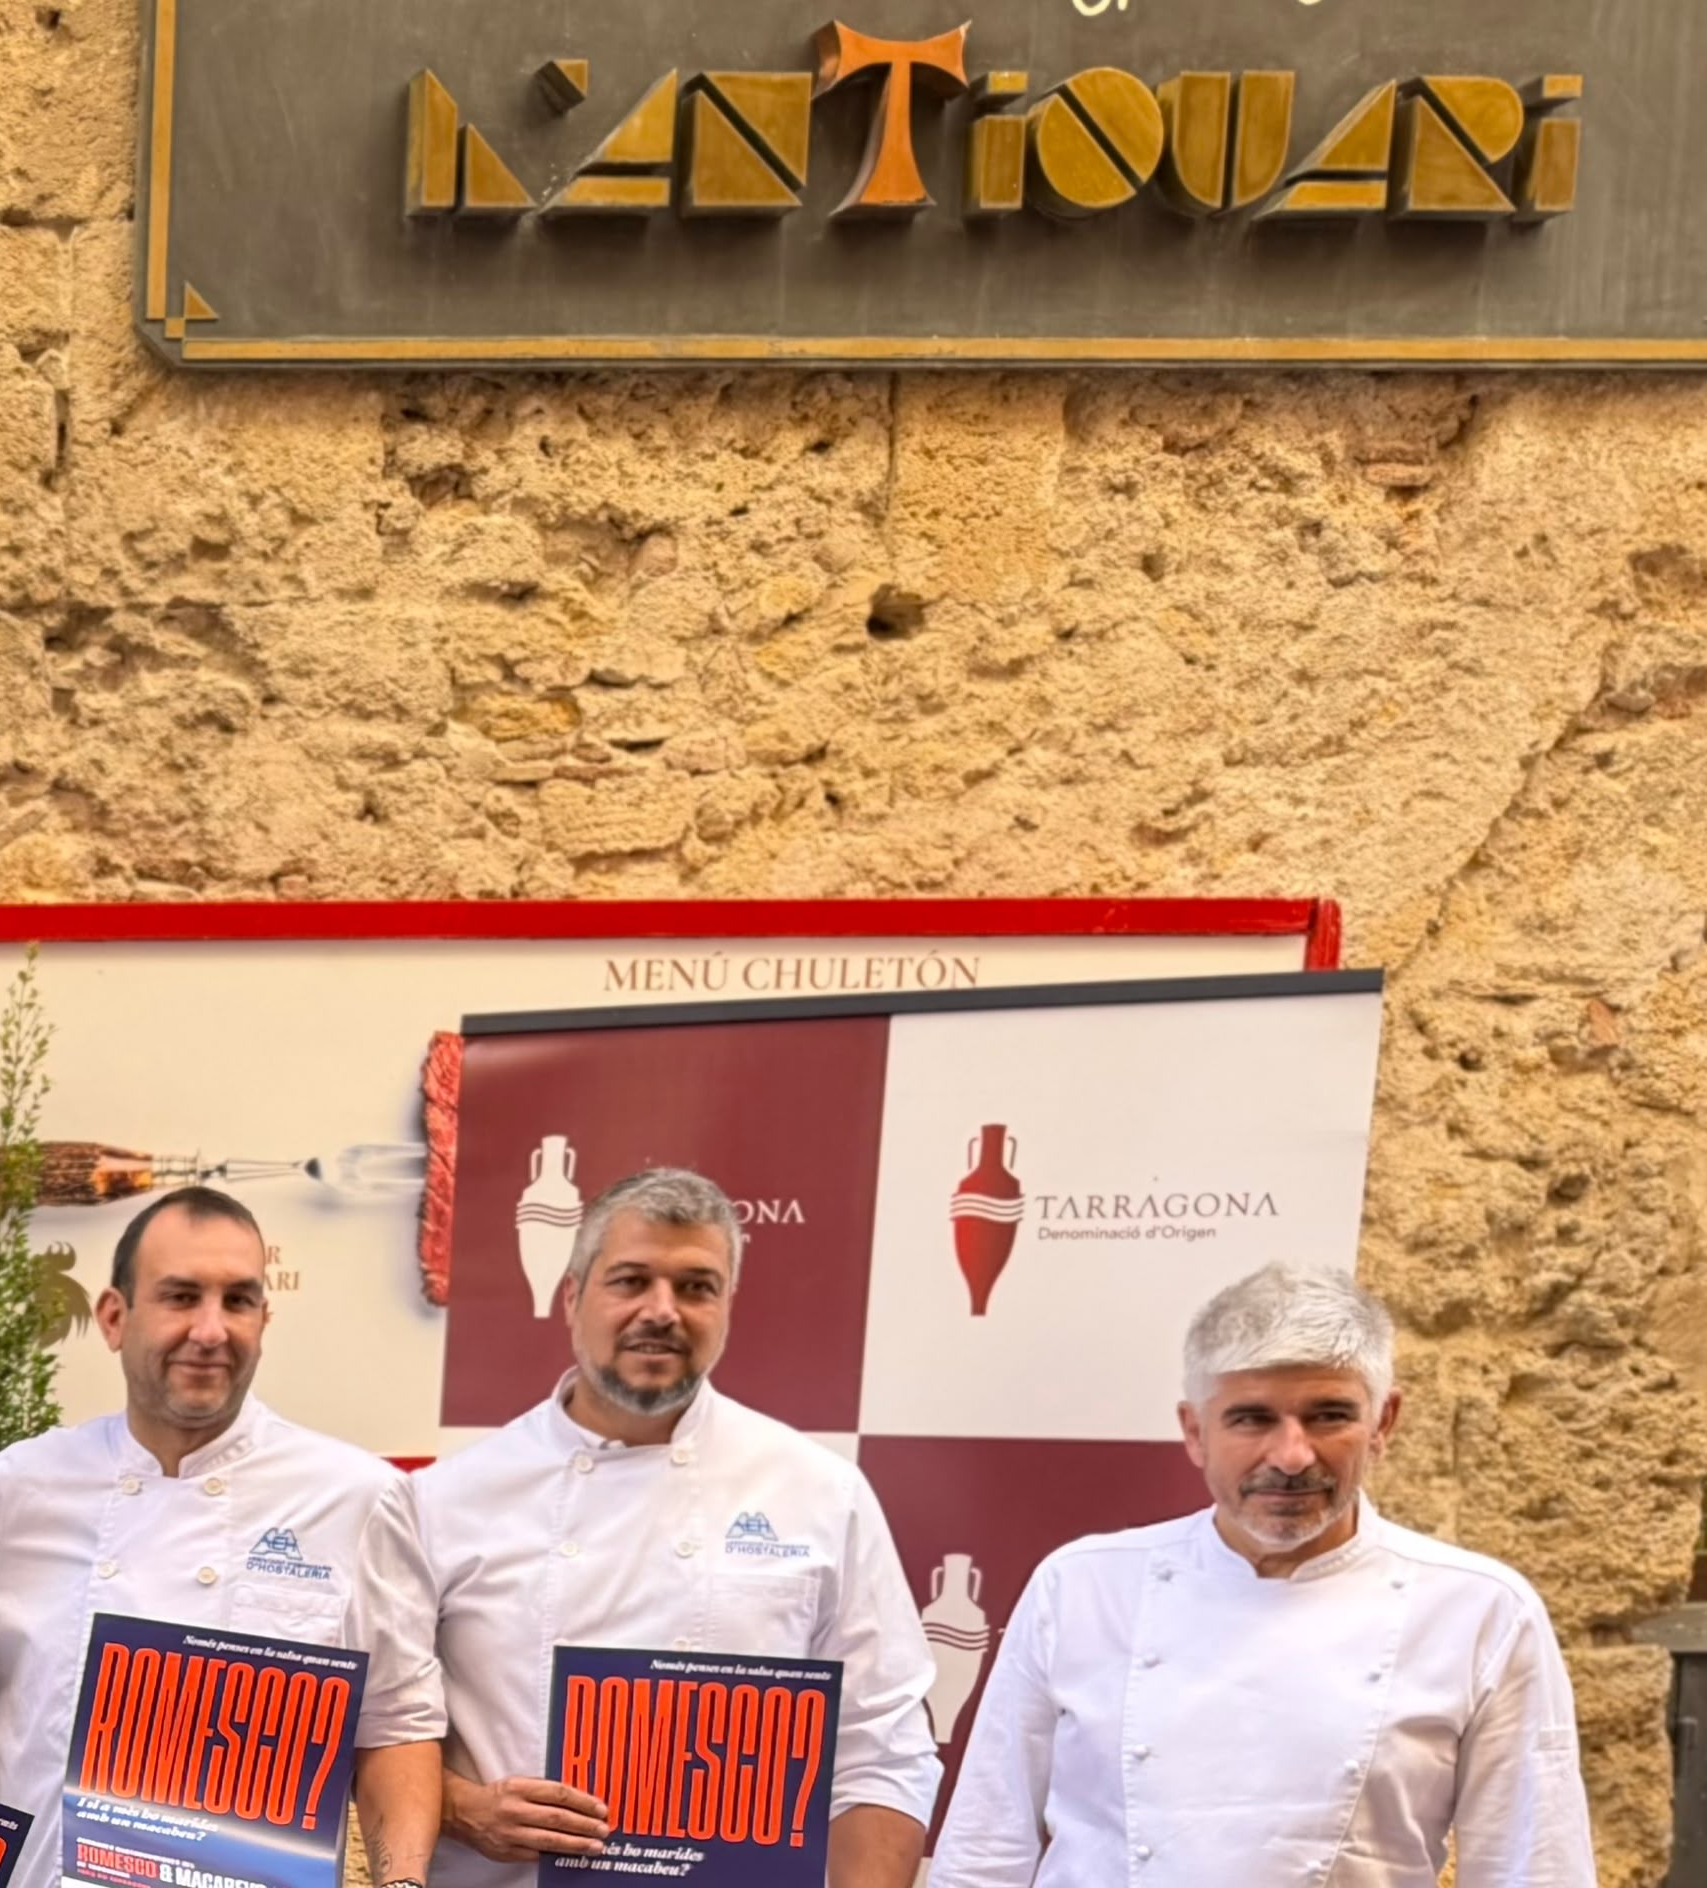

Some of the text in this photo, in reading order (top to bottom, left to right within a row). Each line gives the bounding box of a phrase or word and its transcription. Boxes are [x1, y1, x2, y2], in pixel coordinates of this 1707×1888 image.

[604, 950, 980, 992] MENÚ CHULETÓN
[1035, 1191, 1279, 1220] TARRAGONA
[1039, 1224, 1216, 1243] Denominació d'Origen
[79, 1642, 351, 1830] ROMESCO?
[561, 1675, 825, 1848] ROMESCO?
[77, 1843, 157, 1879] ROMESCO
[159, 1862, 172, 1881] &
